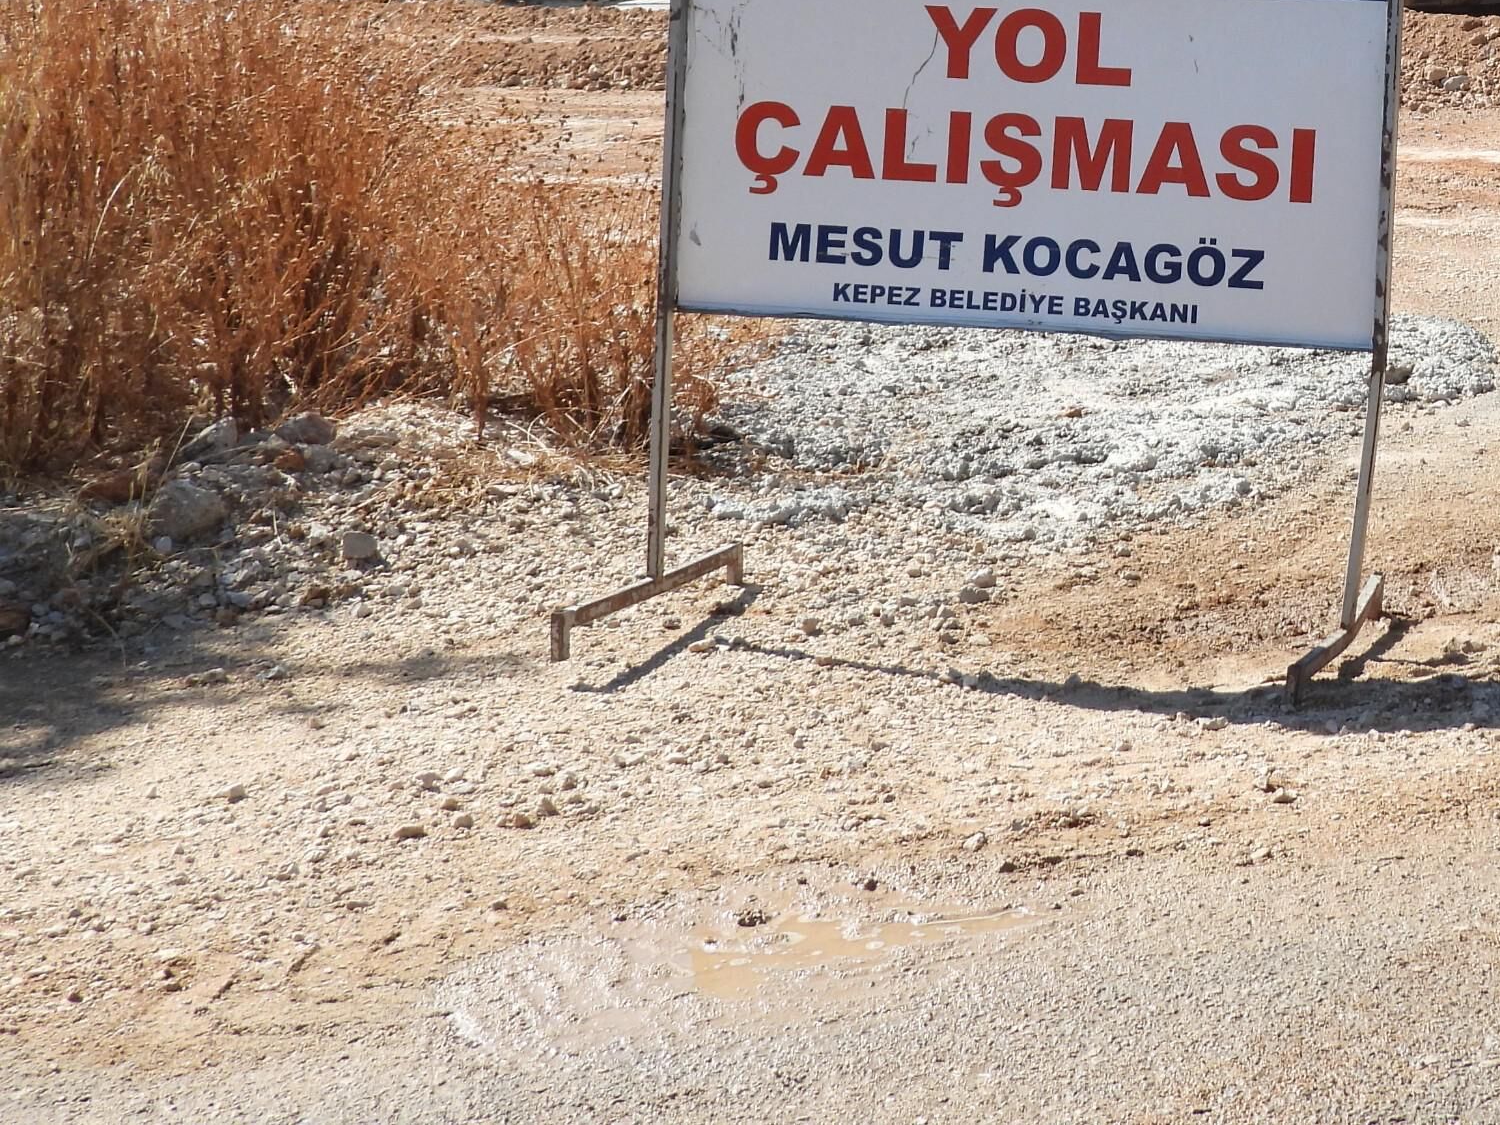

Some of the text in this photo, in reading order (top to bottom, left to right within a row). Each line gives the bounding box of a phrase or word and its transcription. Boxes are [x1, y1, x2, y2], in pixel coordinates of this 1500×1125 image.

[925, 5, 1132, 87] YOL
[734, 101, 1316, 208] ÇALIŞMASI
[768, 222, 1265, 290] MESUT KOCAGÖZ
[832, 282, 1198, 326] KEPEZ BELEDİYE BAŞKANI
